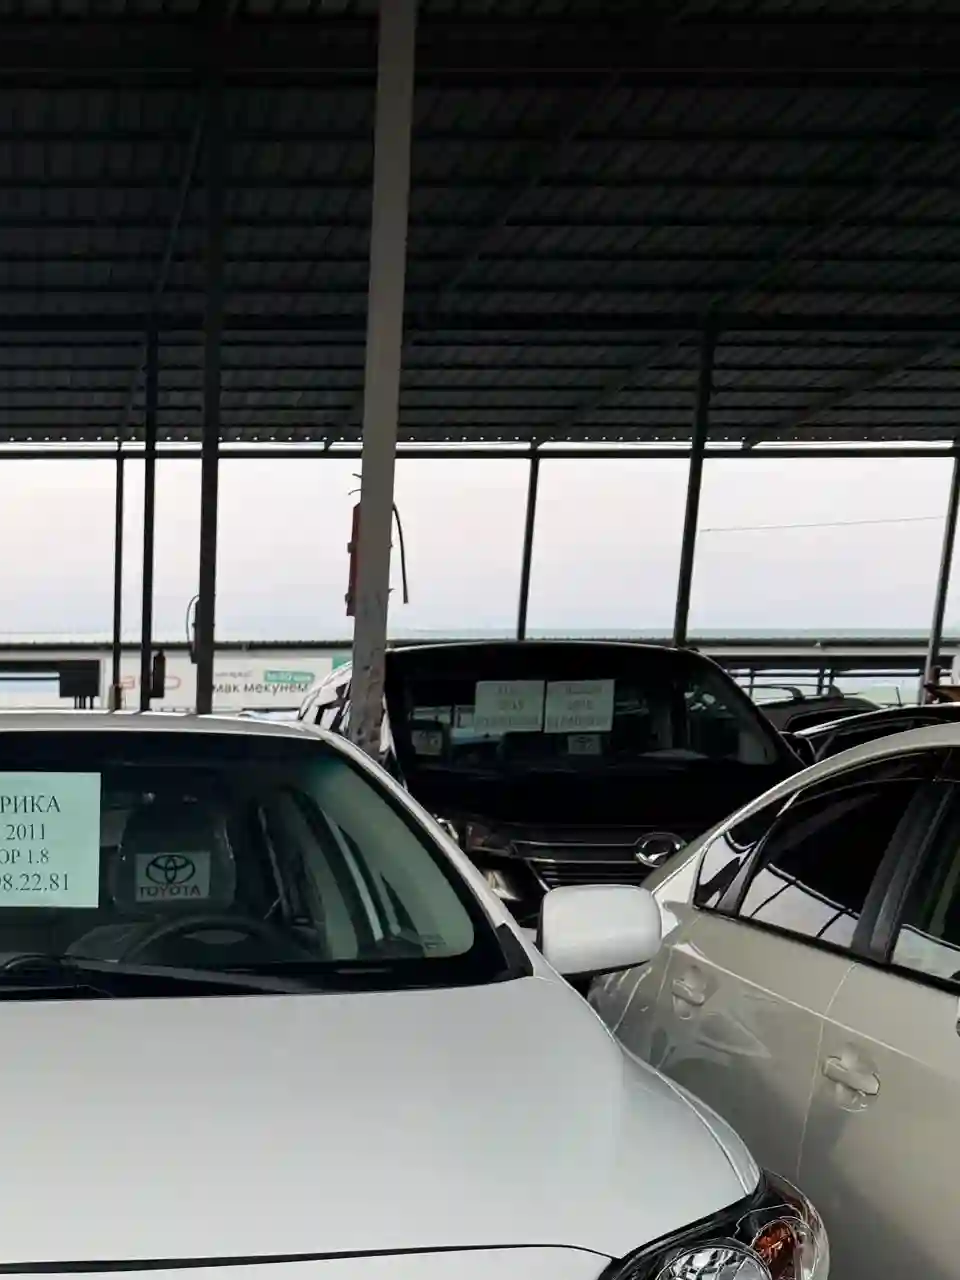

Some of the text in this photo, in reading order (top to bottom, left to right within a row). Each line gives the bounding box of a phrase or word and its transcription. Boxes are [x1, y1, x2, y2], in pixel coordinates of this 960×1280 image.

[5, 823, 45, 840] 2011
[28, 849, 50, 864] 1.8
[140, 884, 201, 898] TOYOTA
